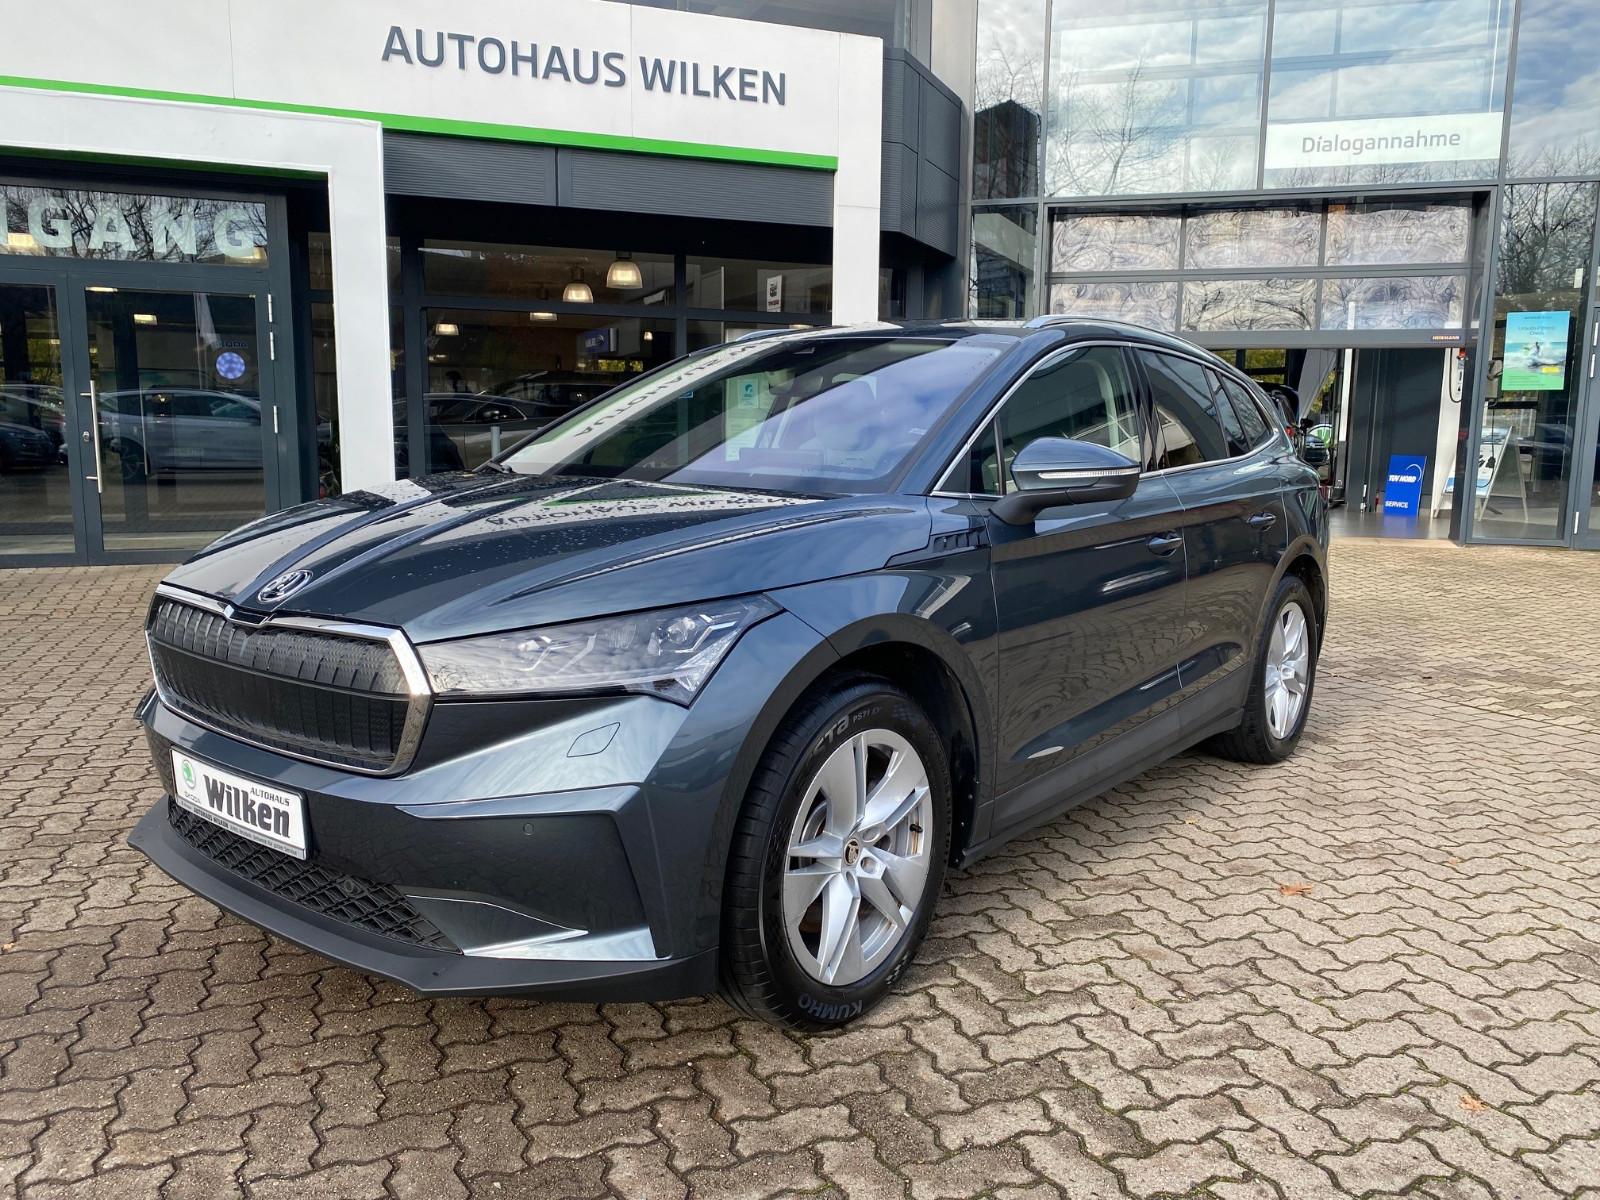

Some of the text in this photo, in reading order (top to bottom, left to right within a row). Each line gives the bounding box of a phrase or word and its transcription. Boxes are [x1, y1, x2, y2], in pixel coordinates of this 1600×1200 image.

[381, 25, 786, 106] AUTOHAUS WILKEN
[1302, 130, 1461, 155] Dialogannahme
[1385, 500, 1408, 508] SERVICE
[203, 774, 290, 838] Wilken
[250, 786, 290, 806] AUTOHAUS
[798, 993, 863, 1019] KUMHO
